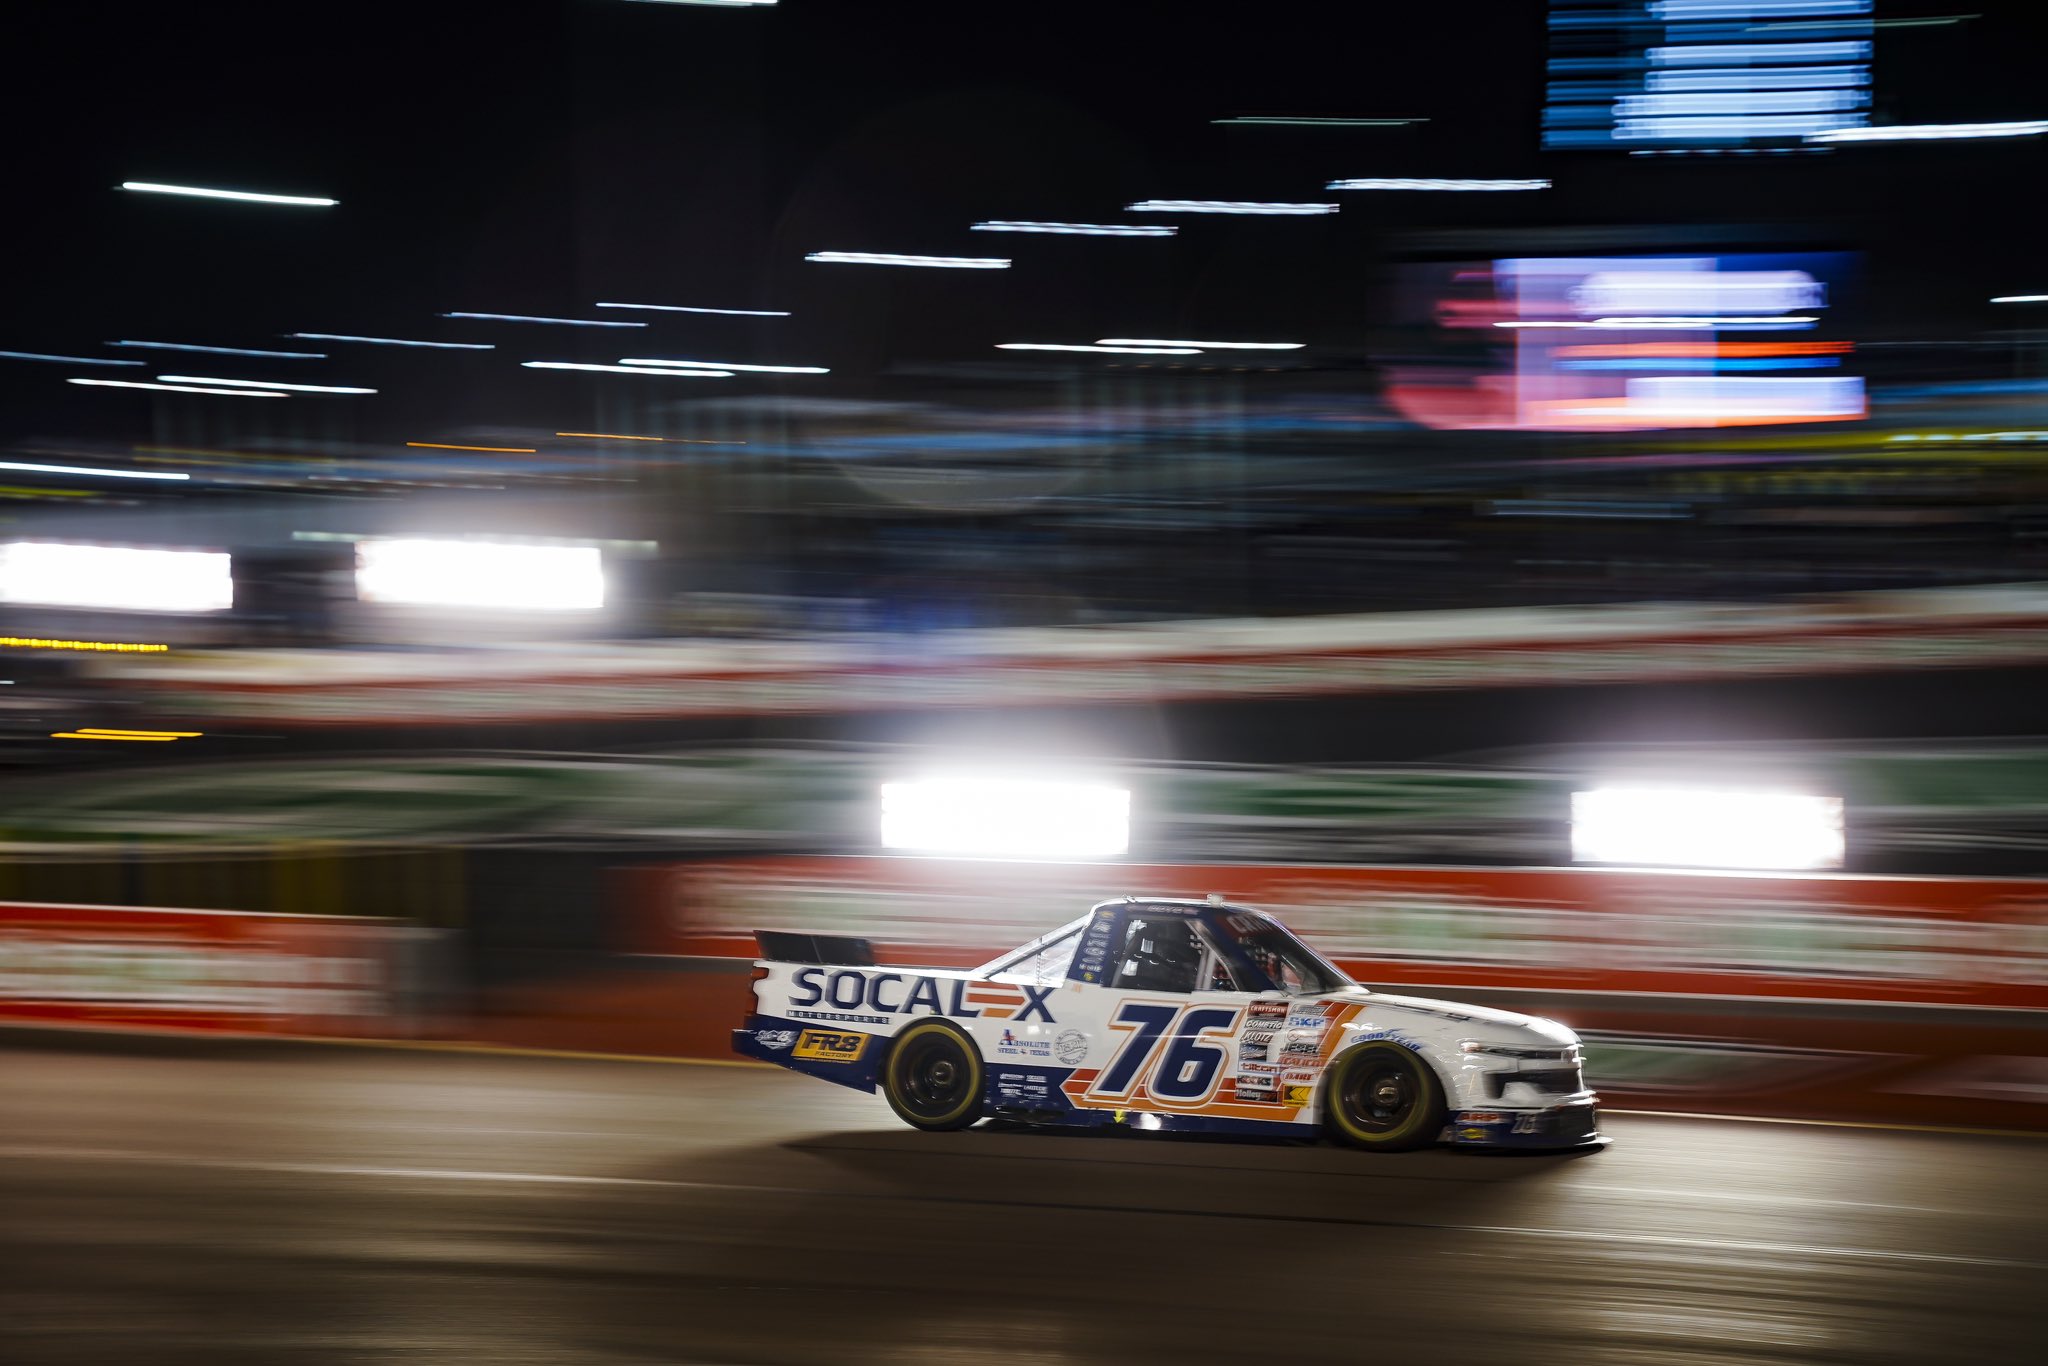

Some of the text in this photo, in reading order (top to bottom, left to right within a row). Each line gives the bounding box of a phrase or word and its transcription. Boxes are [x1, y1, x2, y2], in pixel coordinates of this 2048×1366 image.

[1250, 1005, 1285, 1013] CRAFTSMAN
[788, 1010, 888, 1024] MOTORSPORTS
[1288, 1017, 1324, 1027] SKF
[802, 1033, 861, 1052] FR8
[1093, 1001, 1236, 1102] 76
[1236, 1089, 1260, 1100] Holley
